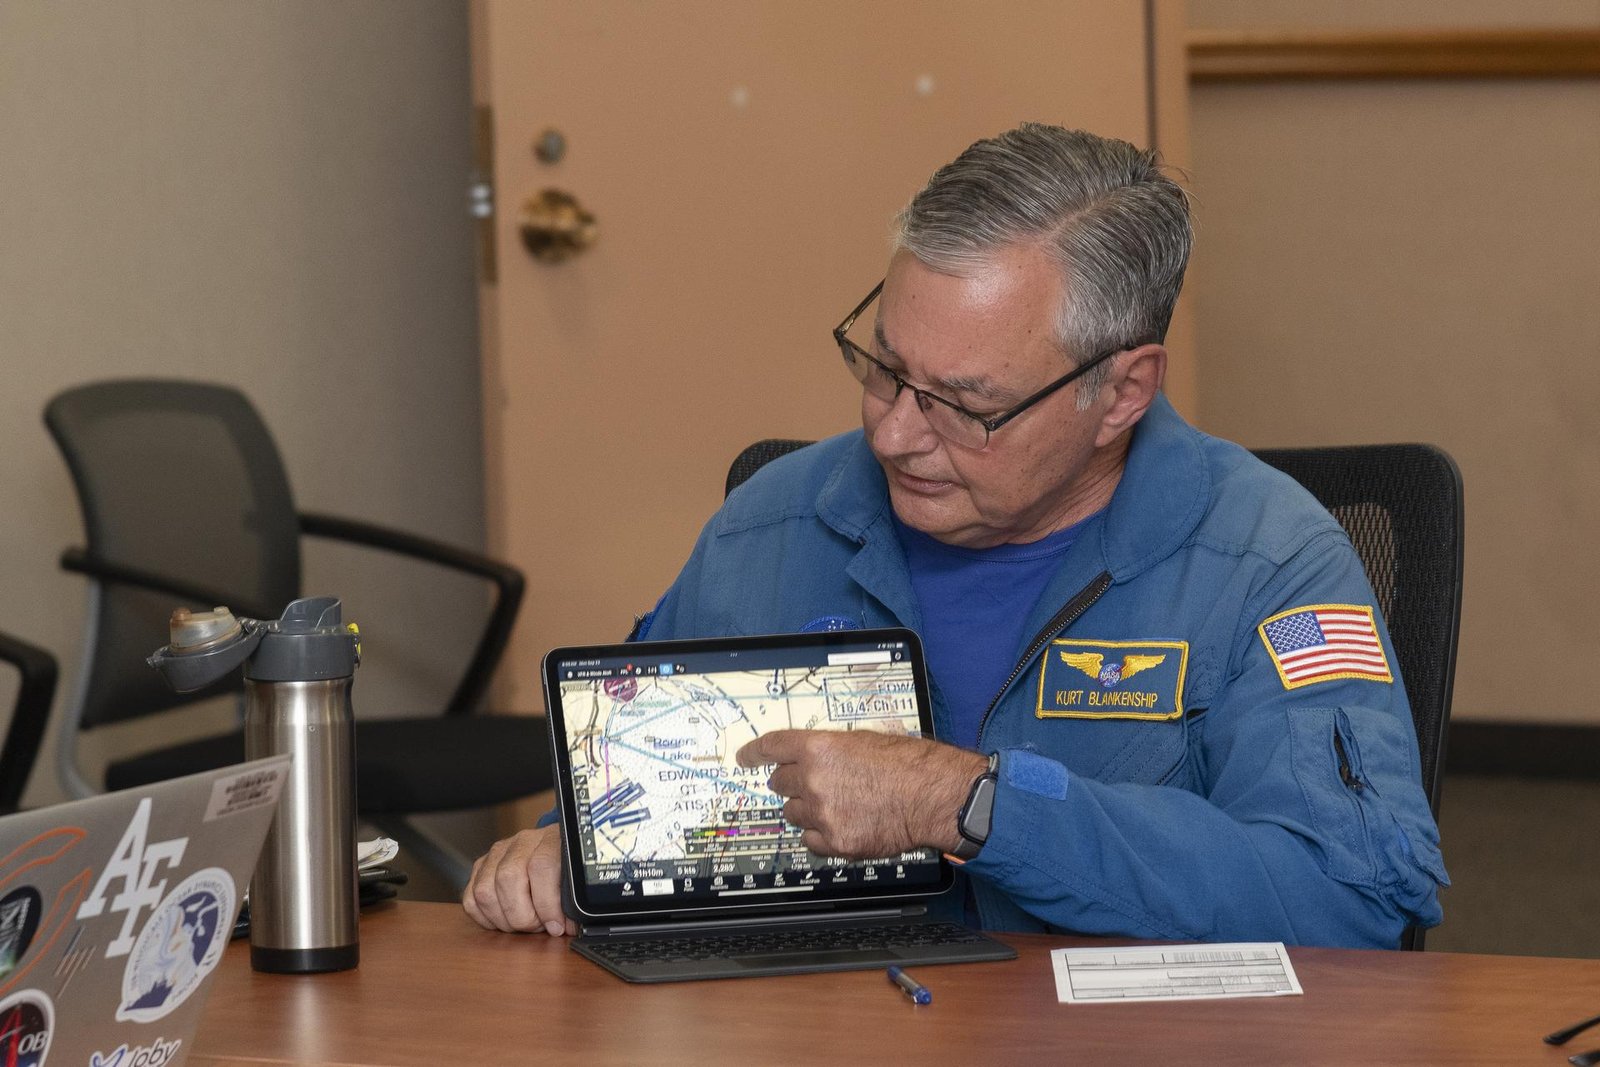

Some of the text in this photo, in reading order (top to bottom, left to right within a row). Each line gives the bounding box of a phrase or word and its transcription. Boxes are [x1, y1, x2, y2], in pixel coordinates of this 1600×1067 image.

[873, 698, 889, 712] Ch
[893, 697, 913, 711] 111
[1056, 690, 1158, 708] KURT BLANKENSHIP
[654, 736, 697, 749] Rogers
[662, 751, 691, 761] Lake
[658, 767, 729, 781] EDWARDS
[733, 766, 760, 777] AFB
[900, 851, 926, 862] 2m19s
